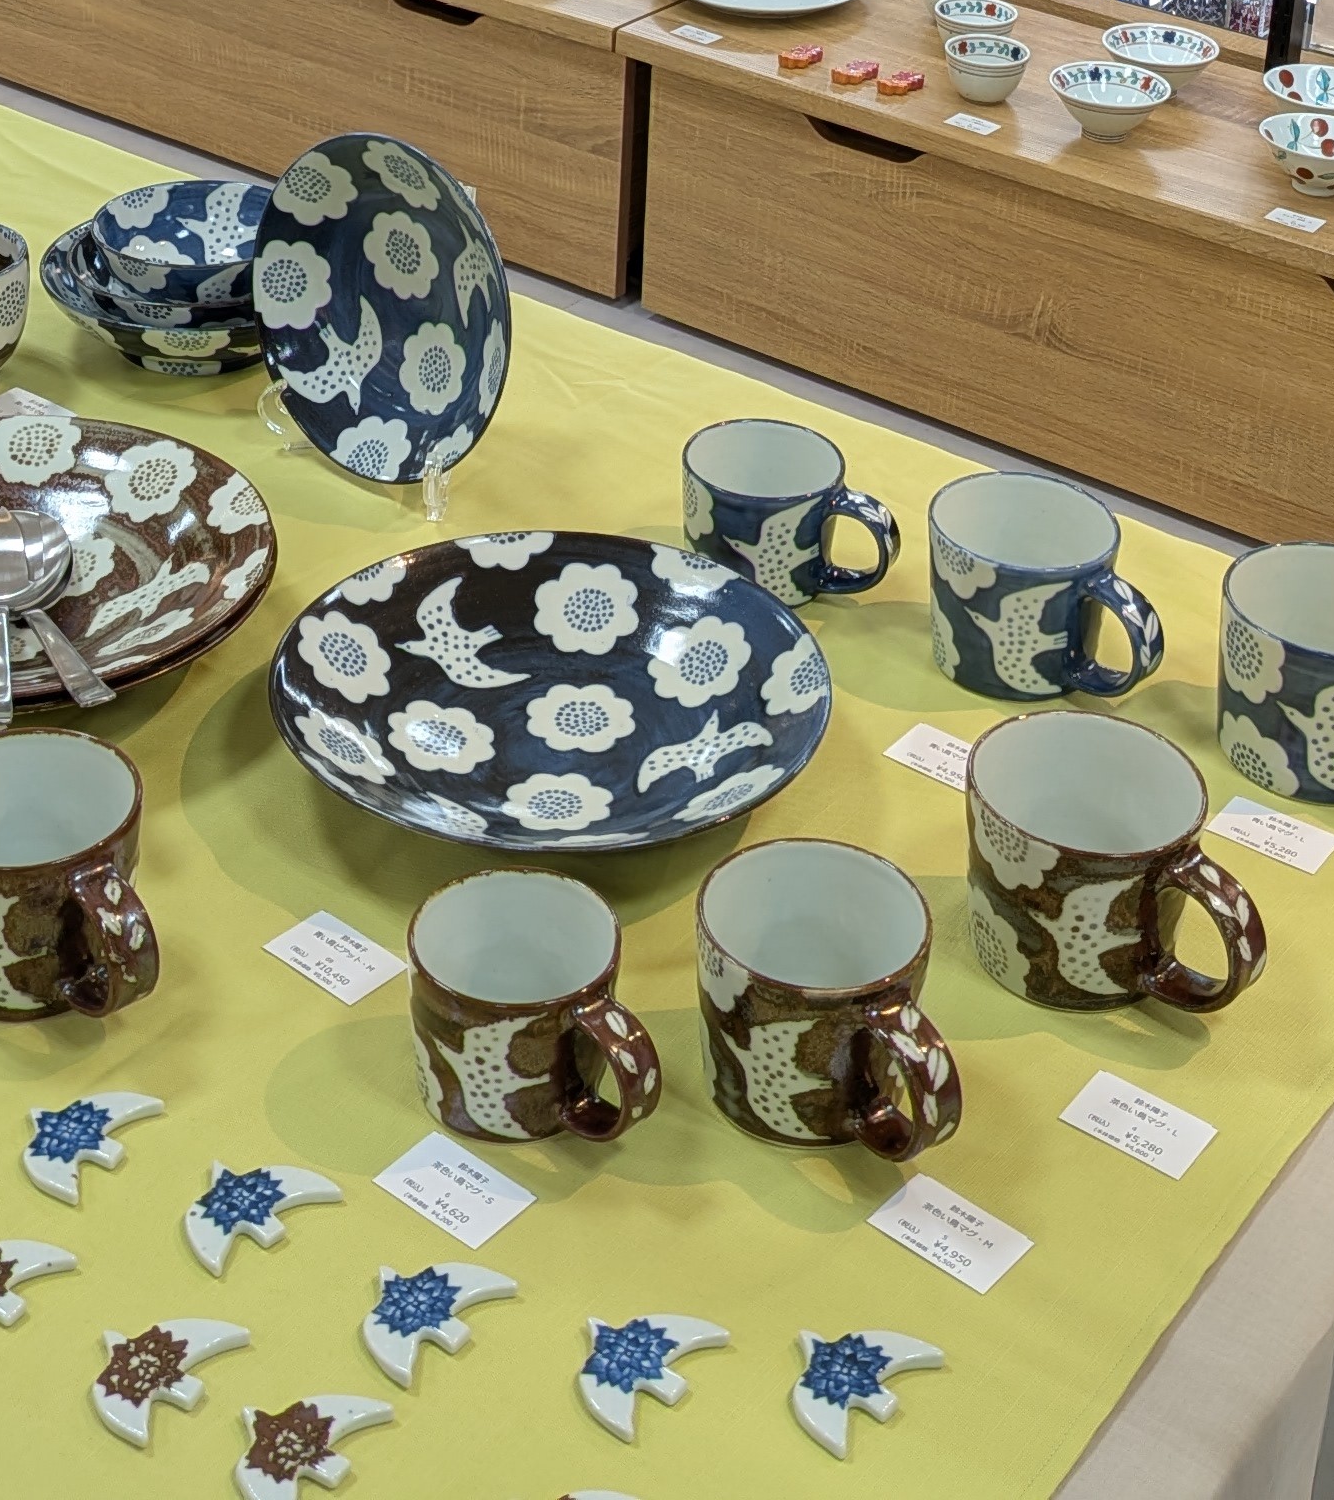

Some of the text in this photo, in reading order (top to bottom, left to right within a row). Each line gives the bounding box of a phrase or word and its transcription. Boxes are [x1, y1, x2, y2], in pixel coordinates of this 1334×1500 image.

[1263, 839, 1298, 858] ¥5,280
[314, 960, 351, 986] ¥10,450
[1124, 1131, 1164, 1156] ¥5,280
[435, 1197, 470, 1224] ¥4,620
[933, 1239, 972, 1267] ¥4,950
